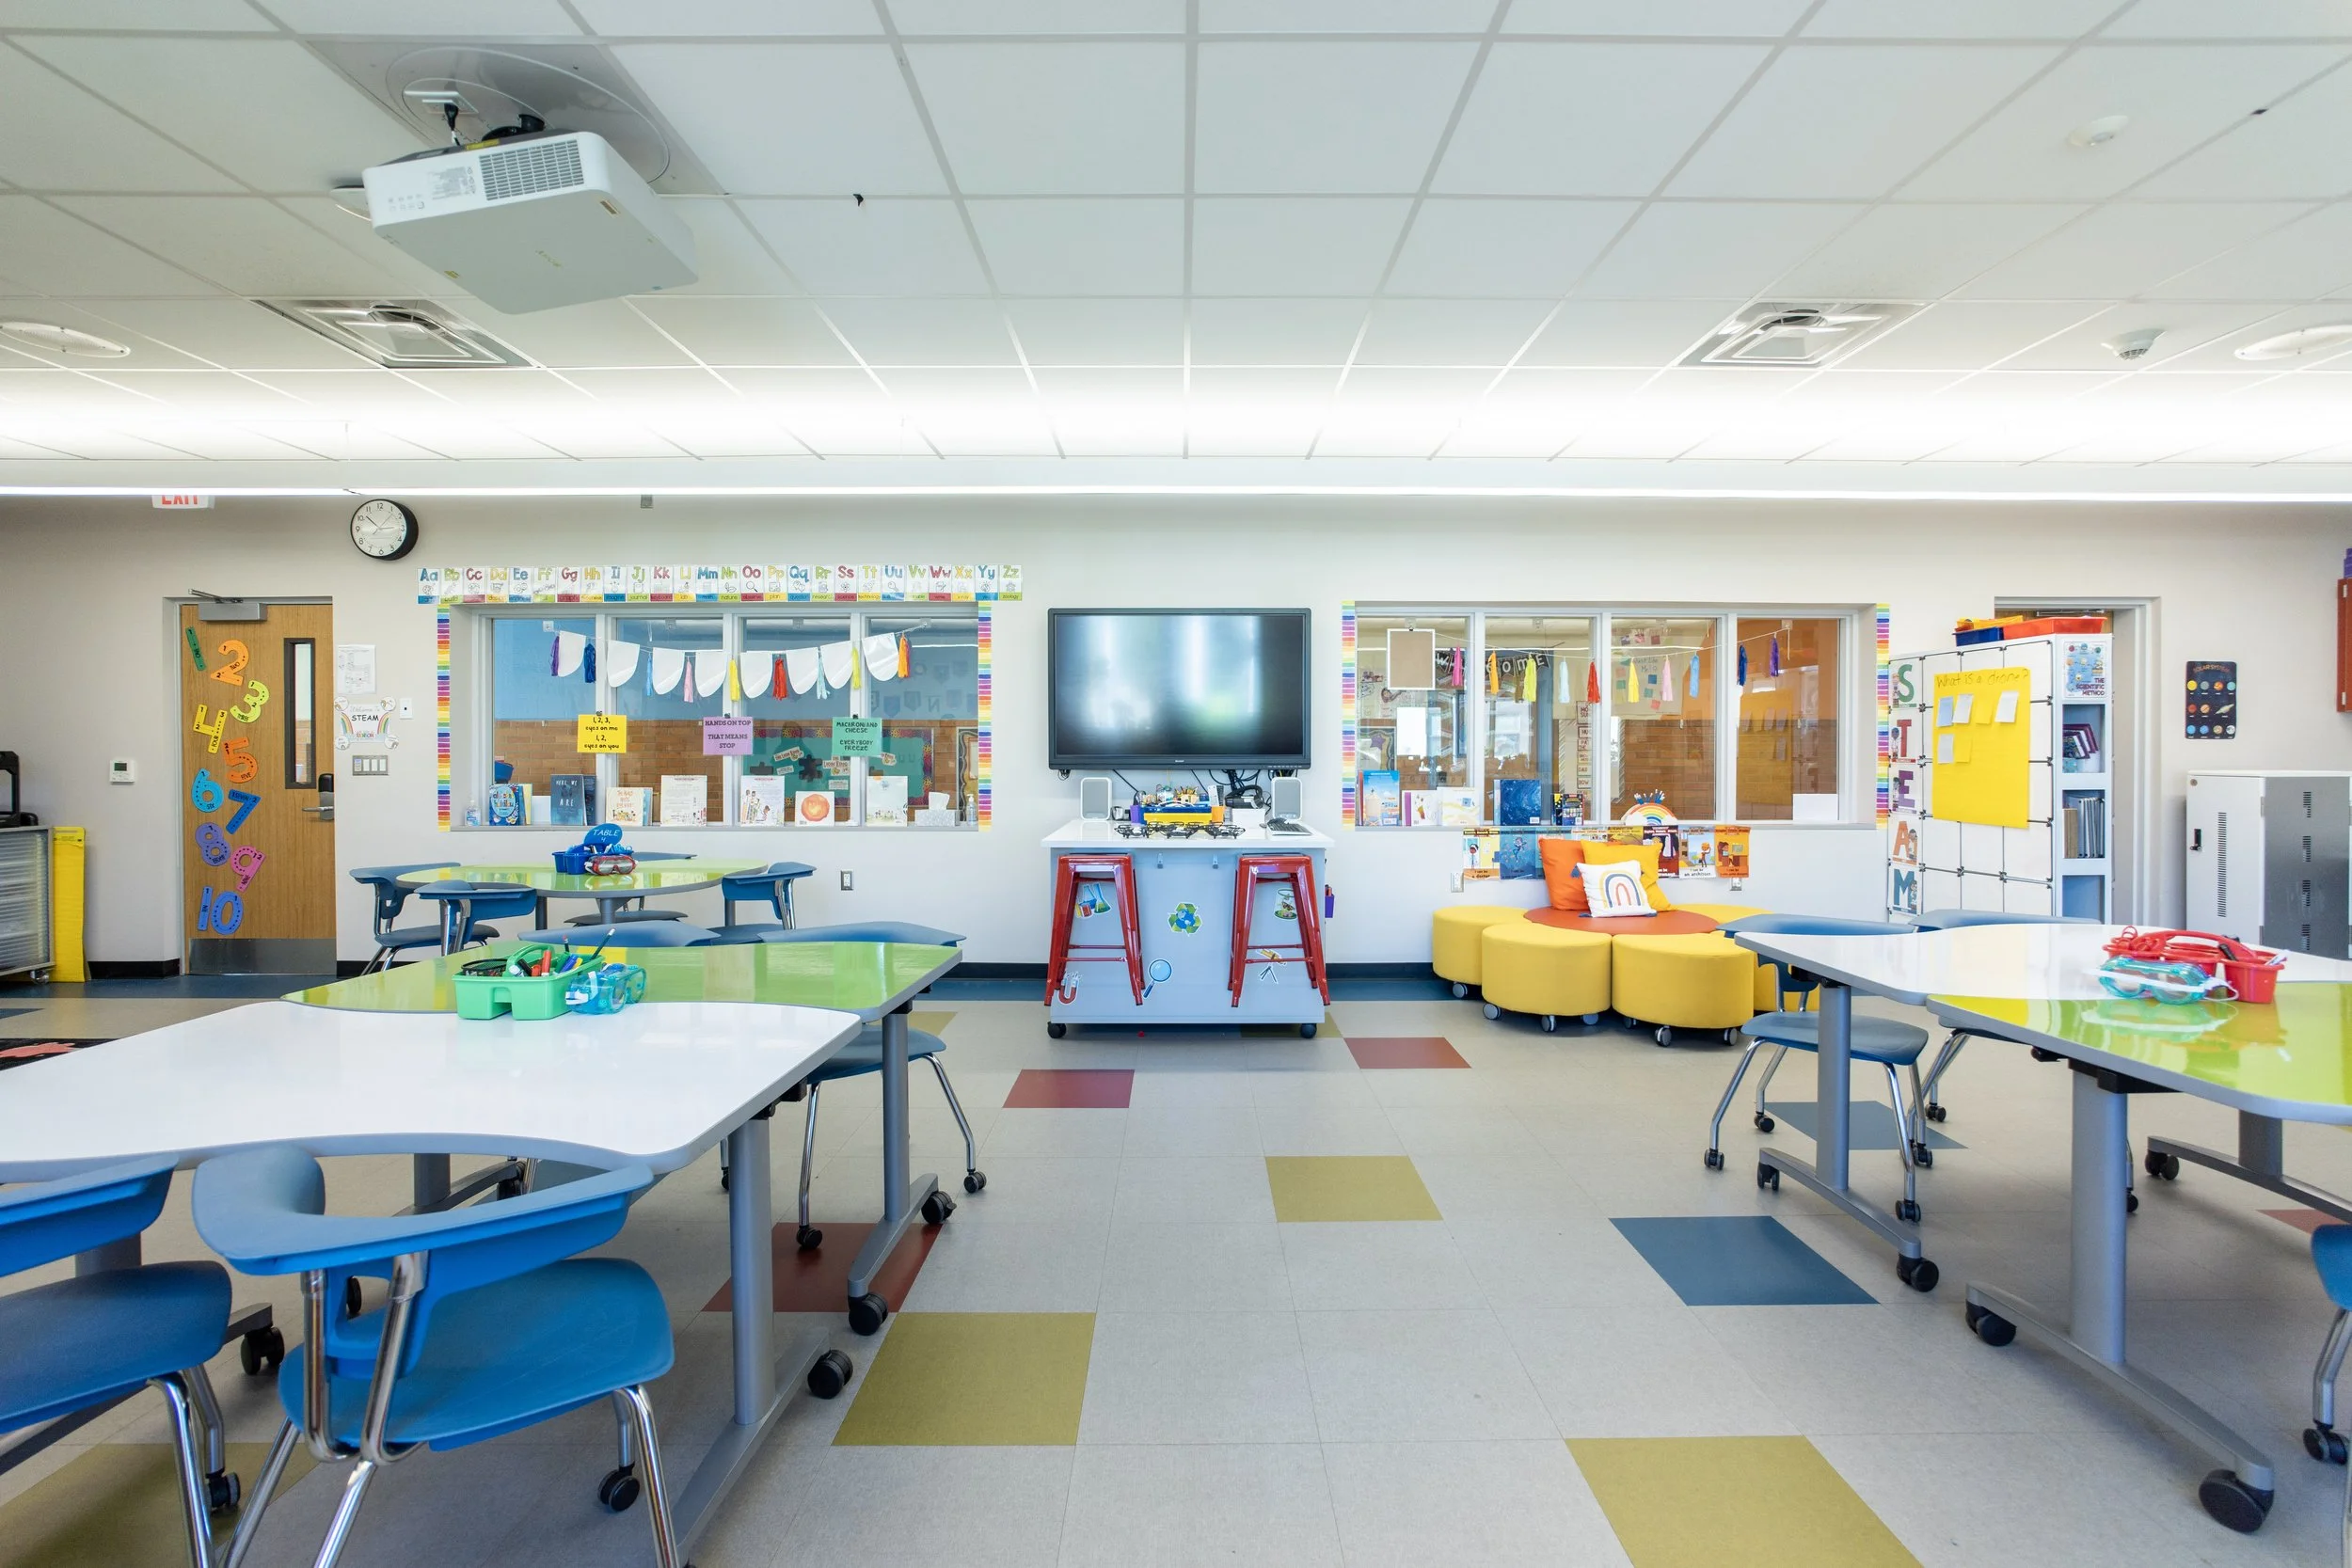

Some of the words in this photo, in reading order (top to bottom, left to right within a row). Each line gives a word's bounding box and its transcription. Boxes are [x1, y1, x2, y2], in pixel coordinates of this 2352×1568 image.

[420, 568, 438, 581] Aa
[444, 568, 460, 581] Bb
[466, 568, 483, 580] Cc
[513, 567, 528, 580] Ee
[538, 567, 553, 580] Ff
[561, 567, 578, 582] Gg
[584, 567, 601, 580] Hh
[611, 566, 620, 579] Ii
[631, 566, 645, 583] Jj
[653, 566, 670, 579] Kk
[698, 567, 718, 579] Mm
[721, 566, 737, 579] Nn
[742, 565, 761, 578] Oo
[767, 565, 785, 582] Pp
[790, 566, 809, 583] Qq
[815, 566, 831, 579] Rr
[838, 565, 854, 578] Ss
[862, 565, 877, 578] Tt
[885, 565, 903, 578] Uu
[908, 565, 926, 578] Vv
[929, 565, 951, 578] Ww
[955, 566, 972, 579] Xx
[978, 565, 995, 580] Yy
[1002, 565, 1019, 578] Zz
[185, 626, 207, 671] 1
[210, 640, 249, 686] 2
[1936, 674, 1962, 688] What
[1965, 674, 1972, 684] is
[1989, 668, 2029, 685] drone?
[230, 680, 270, 723] 3
[193, 704, 227, 754] 4
[222, 737, 258, 784] 5
[192, 768, 224, 813] 6
[226, 789, 261, 835] 7
[195, 822, 231, 866] 8
[230, 845, 266, 893] 9
[197, 886, 244, 935] 10
